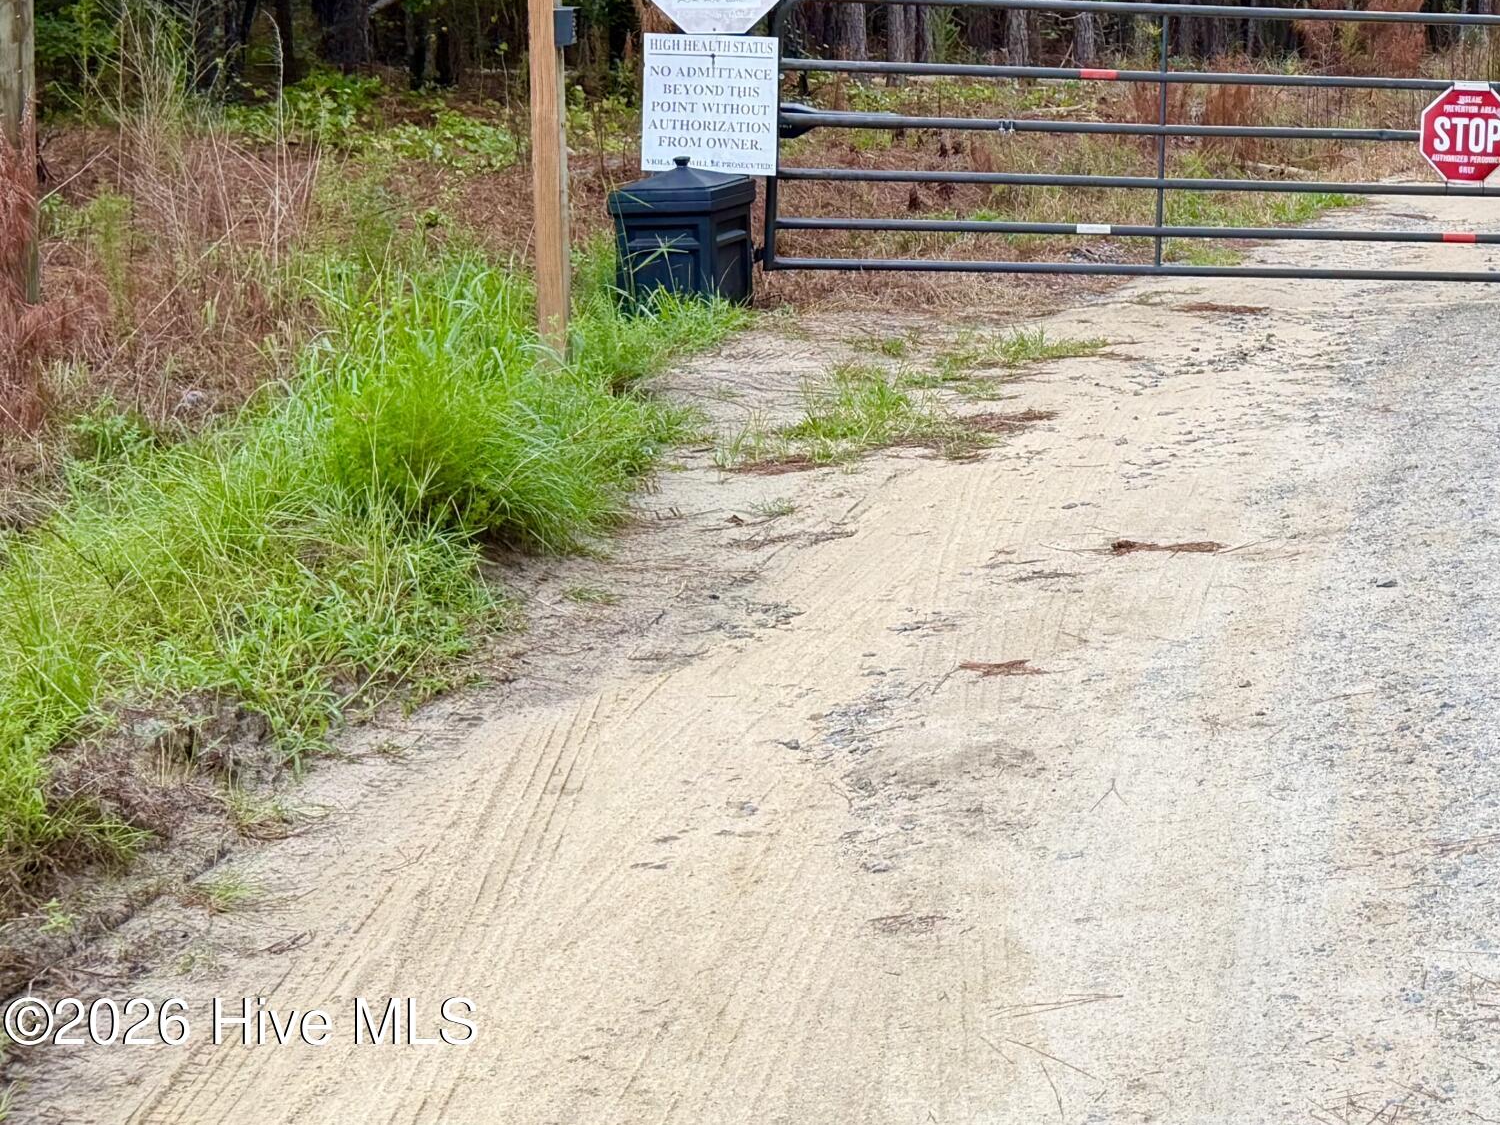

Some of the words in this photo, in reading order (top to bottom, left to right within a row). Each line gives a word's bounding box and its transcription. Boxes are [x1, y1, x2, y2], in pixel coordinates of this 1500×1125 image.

[650, 38, 680, 51] HIGH
[683, 39, 731, 53] HEALTH
[733, 40, 774, 54] STATUS
[650, 65, 672, 77] NO
[676, 66, 773, 81] ADMITTANCE
[663, 83, 724, 96] BEYOND
[728, 85, 760, 98] THIS
[651, 101, 698, 113] POINT
[702, 102, 770, 116] WITHOUT
[648, 118, 771, 134] AUTHORIZATION
[658, 135, 702, 148] FROM
[706, 137, 762, 151] OWNER.
[646, 158, 675, 167] VIOLA
[1470, 155, 1500, 164] PEROEL
